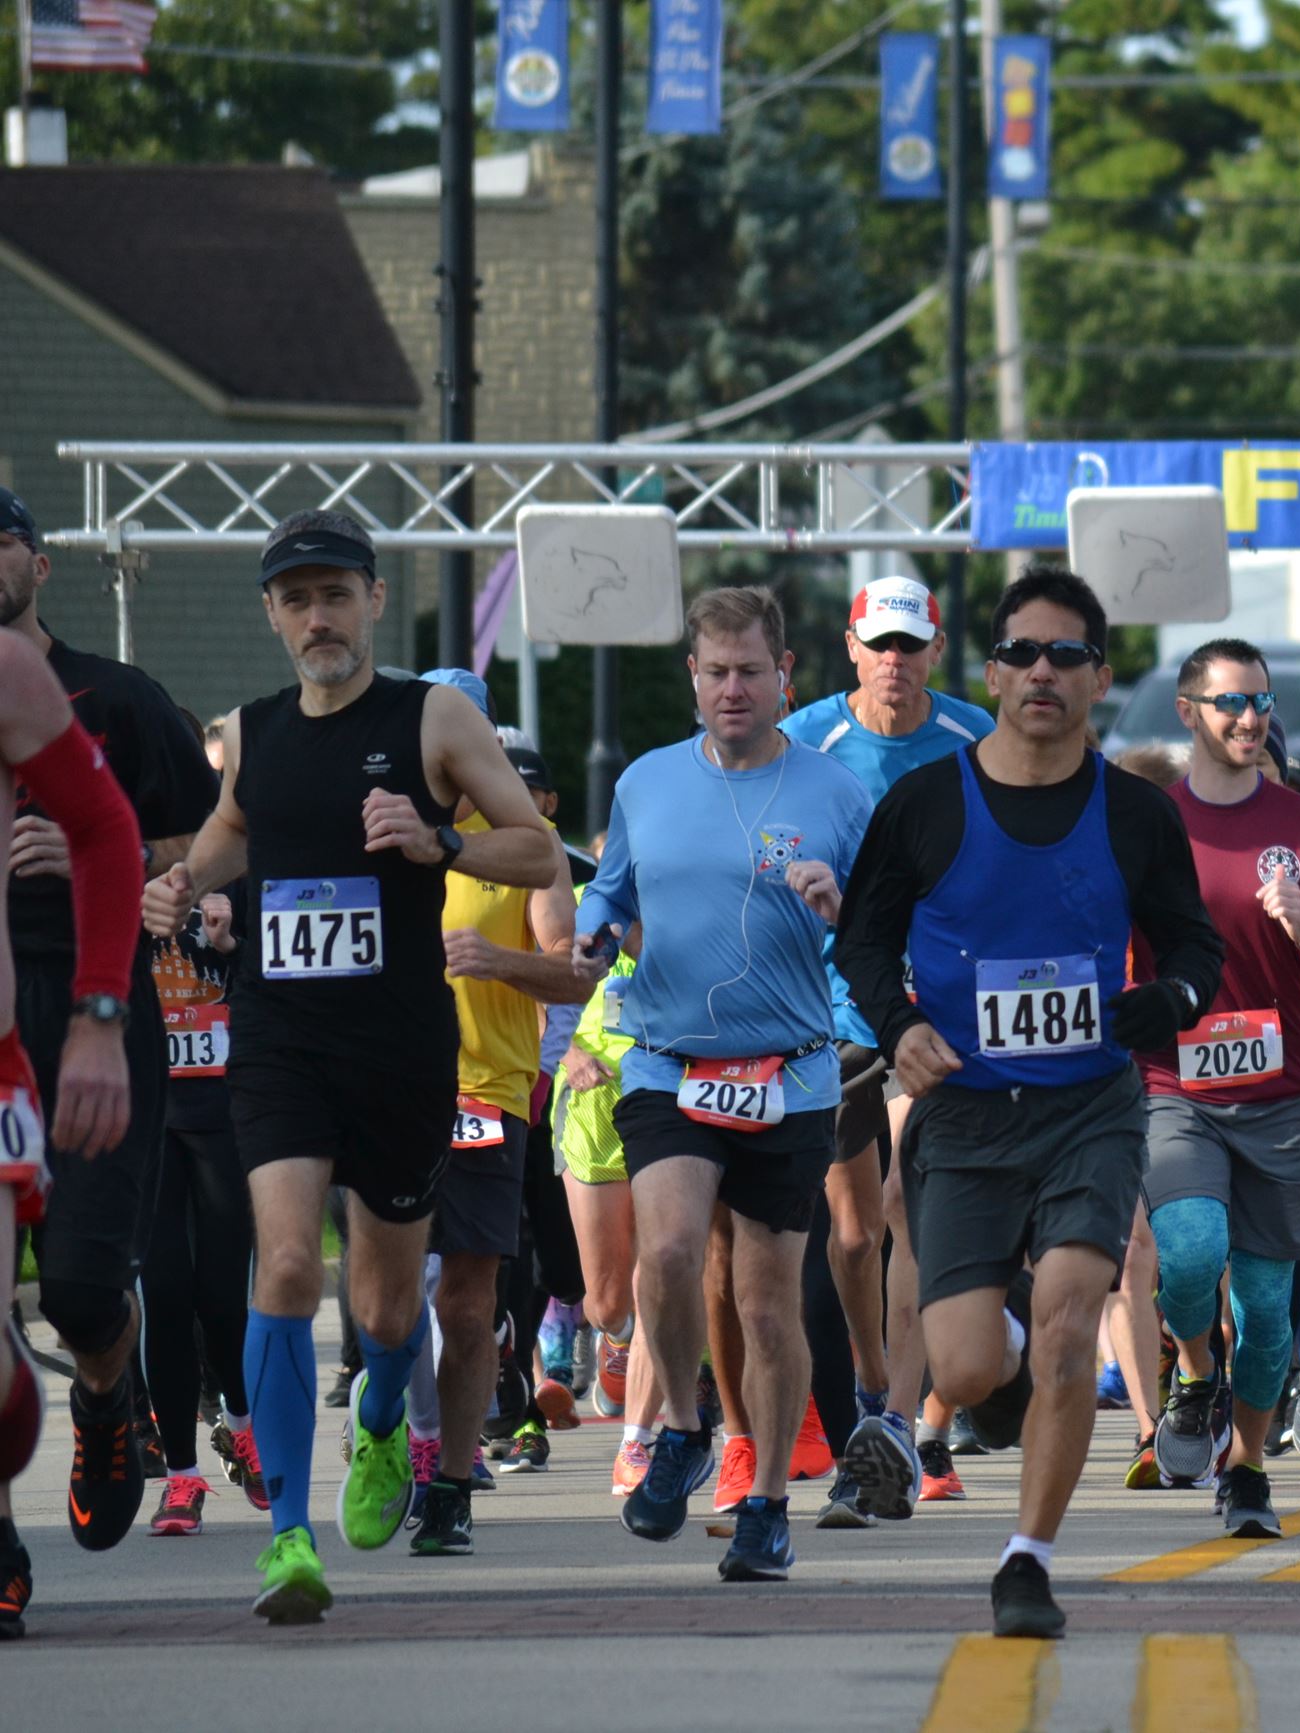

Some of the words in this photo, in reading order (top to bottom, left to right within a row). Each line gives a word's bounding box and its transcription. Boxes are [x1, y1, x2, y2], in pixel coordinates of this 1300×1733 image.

[891, 598, 920, 611] MINI
[297, 889, 316, 900] J3
[267, 911, 377, 968] 1475
[1018, 969, 1037, 980] J3
[984, 987, 1096, 1048] 1484
[1210, 1021, 1228, 1032] J3
[1194, 1038, 1268, 1078] 2020
[721, 1066, 741, 1077] J3
[694, 1081, 768, 1121] 2021
